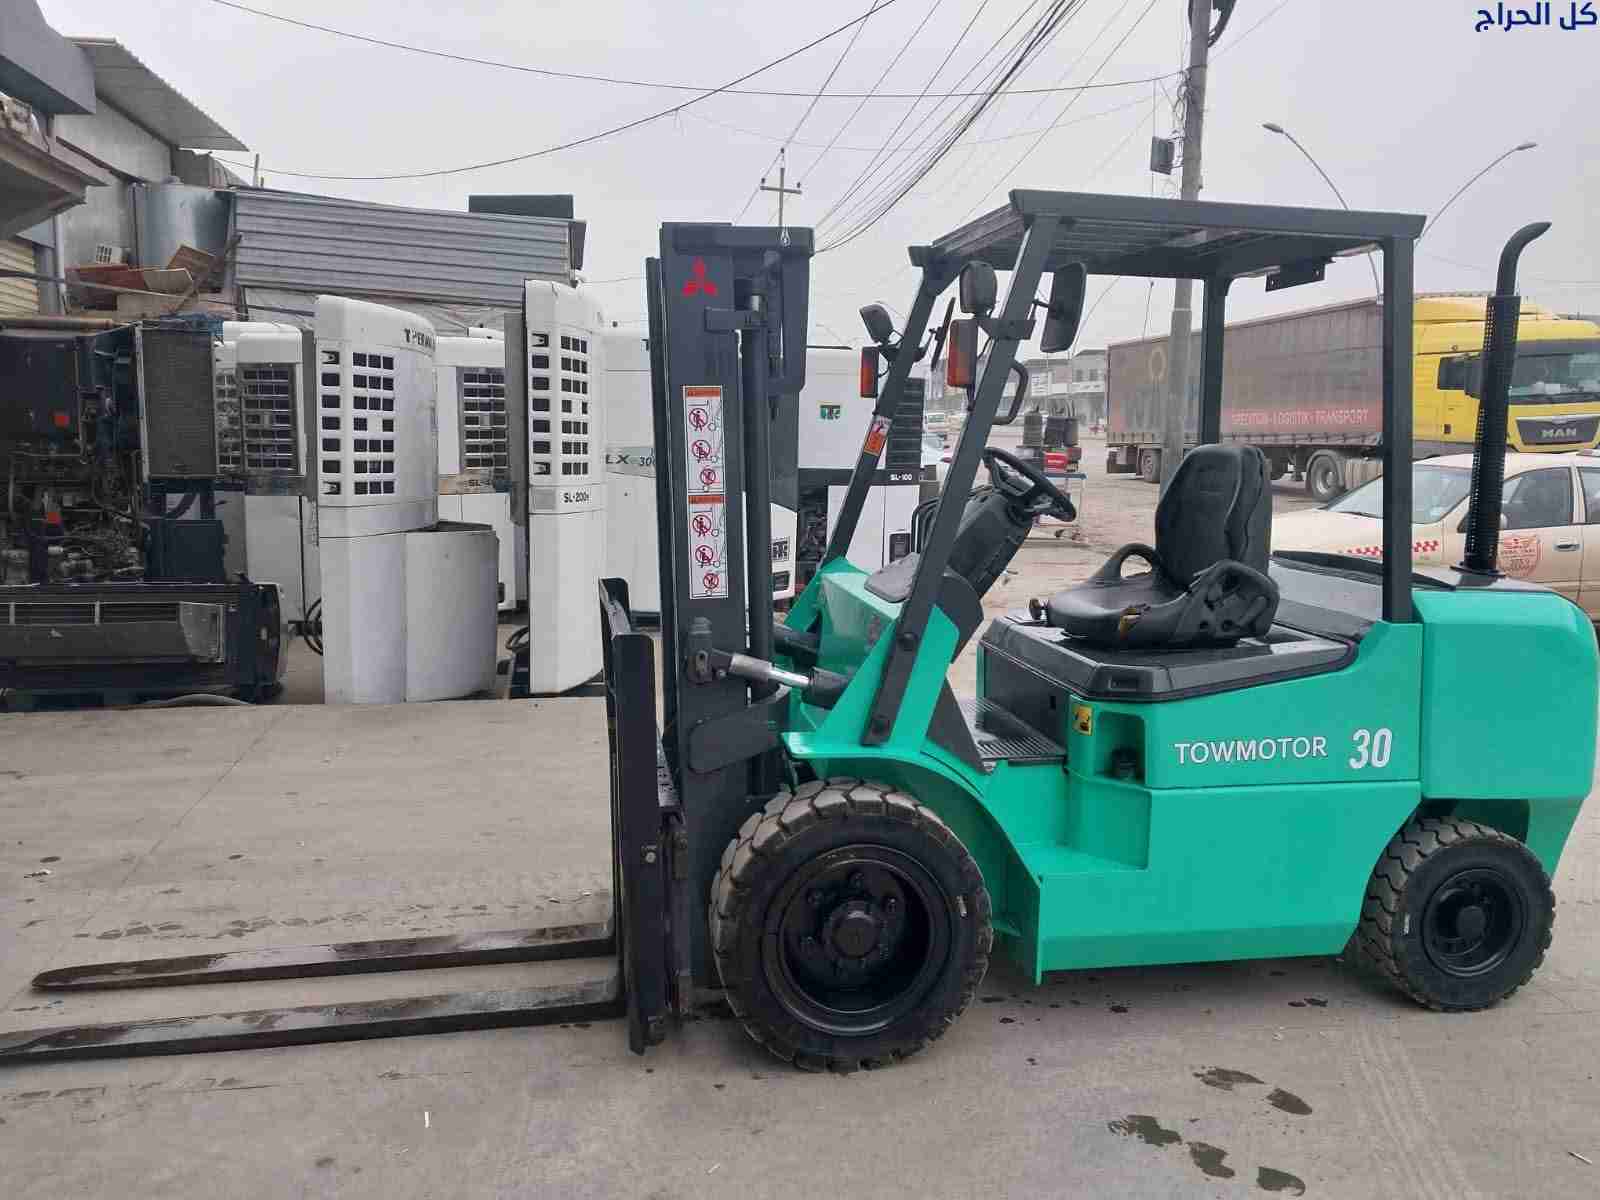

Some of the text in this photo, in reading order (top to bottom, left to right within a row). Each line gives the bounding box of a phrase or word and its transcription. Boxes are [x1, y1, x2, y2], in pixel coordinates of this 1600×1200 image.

[1541, 427, 1577, 439] MAN
[1174, 728, 1393, 769] TOWMOTOR 30
